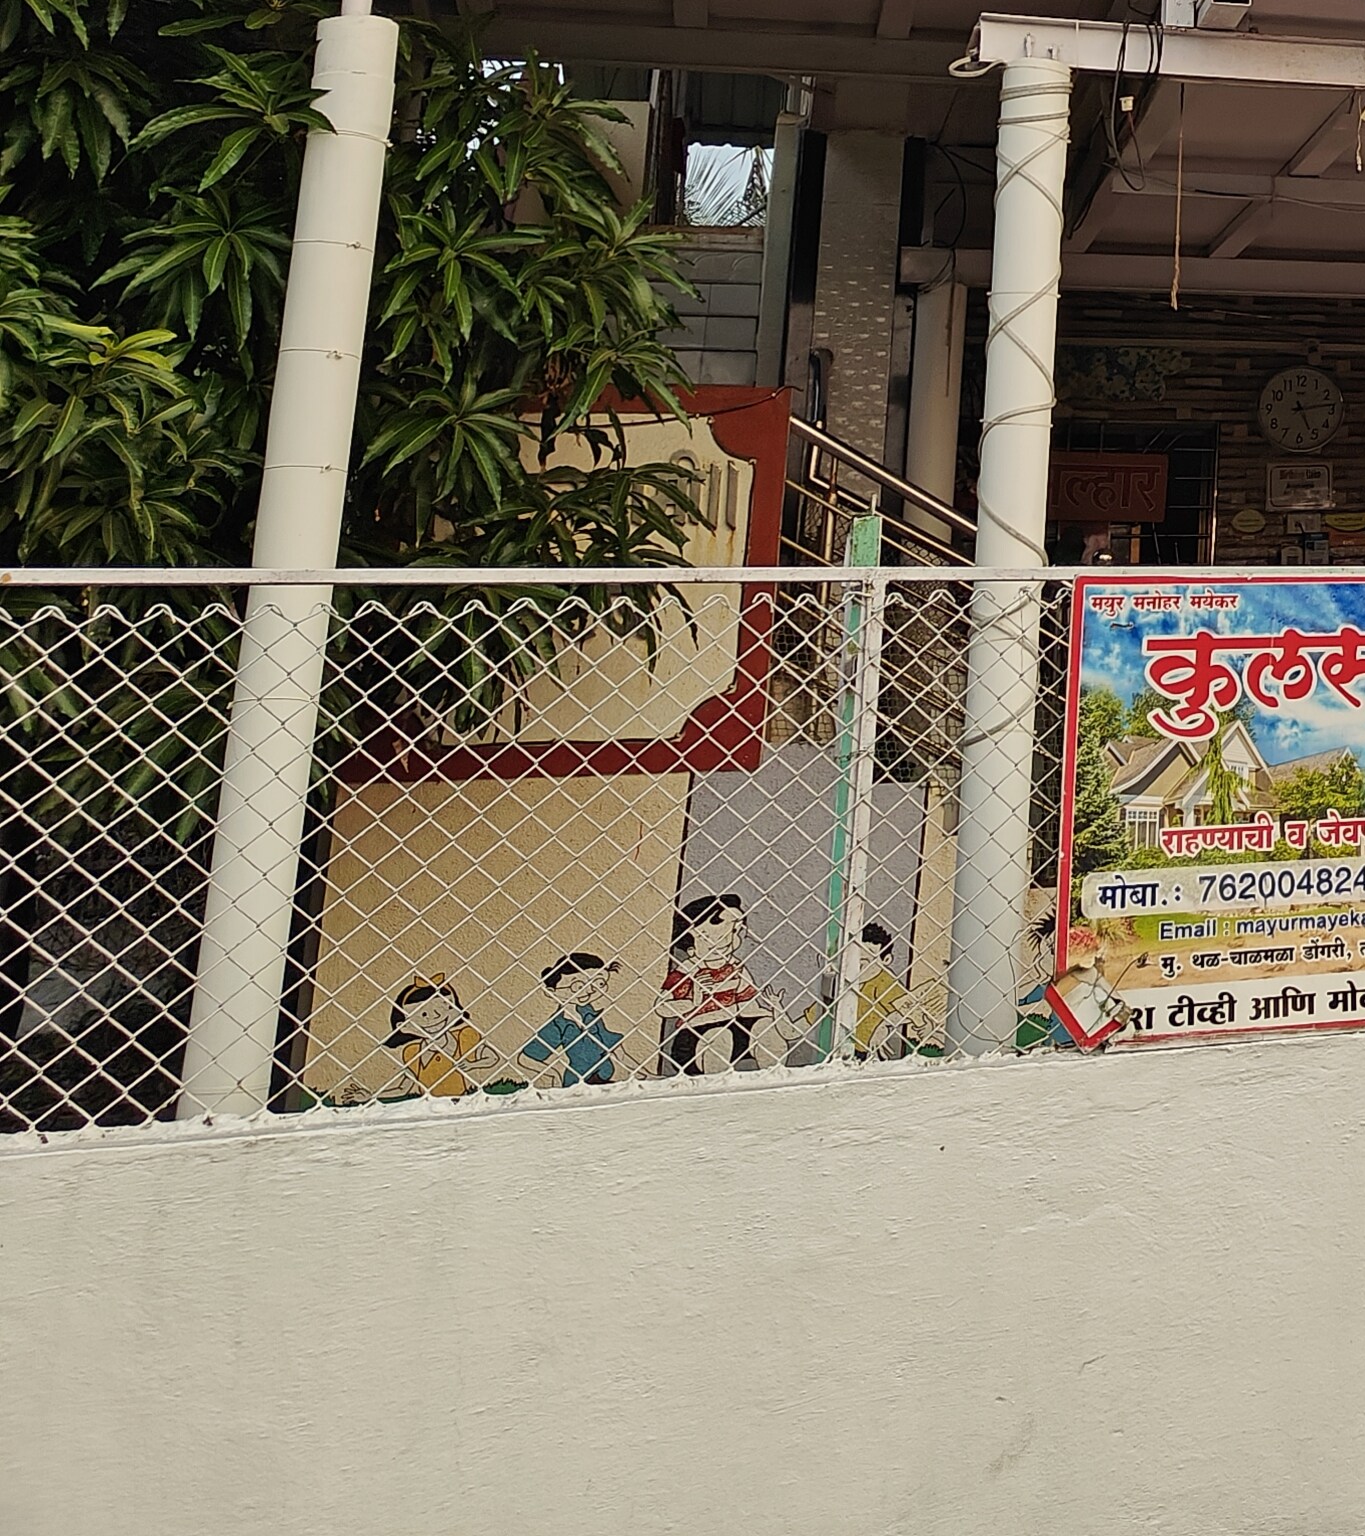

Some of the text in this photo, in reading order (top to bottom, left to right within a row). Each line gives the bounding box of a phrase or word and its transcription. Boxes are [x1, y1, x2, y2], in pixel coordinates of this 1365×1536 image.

[1283, 379, 1292, 391] 11
[1296, 375, 1307, 387] 12
[1272, 390, 1283, 401] 10
[1324, 389, 1330, 400] 2
[1266, 404, 1272, 415] 9
[1271, 418, 1278, 429] 8
[1322, 419, 1329, 428] 4
[1282, 428, 1289, 438] 7
[1296, 433, 1303, 443] 6
[1311, 429, 1318, 440] 5
[1051, 464, 1160, 511] ल्हार
[1091, 589, 1238, 617] मयुर मनोहर मयेकर
[1162, 813, 1274, 855] राहण्याची
[1287, 823, 1306, 846] व
[1160, 919, 1217, 940] Email
[1168, 992, 1237, 1027] टीव्ही
[1249, 986, 1316, 1021] आणि
